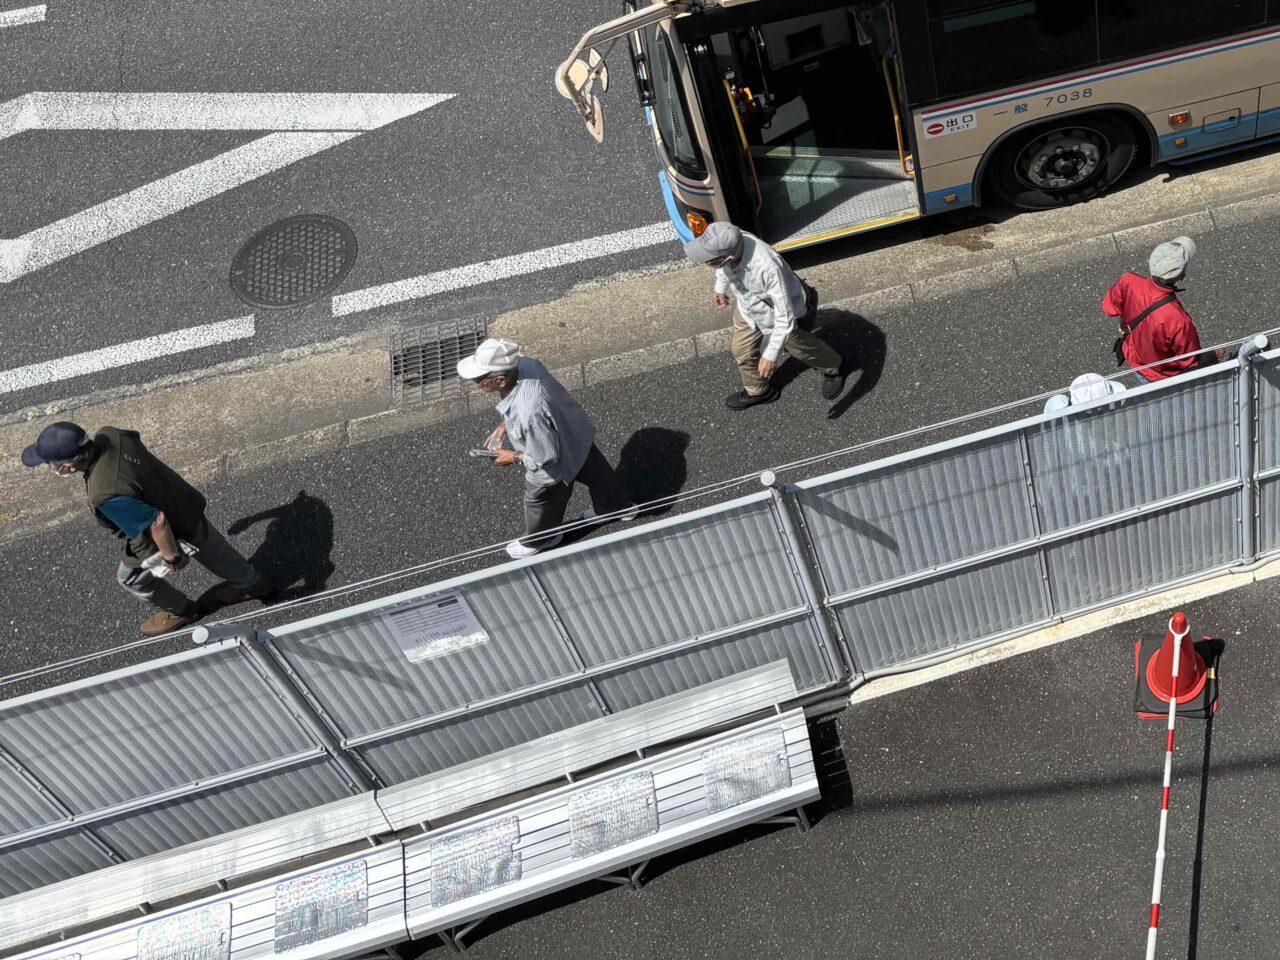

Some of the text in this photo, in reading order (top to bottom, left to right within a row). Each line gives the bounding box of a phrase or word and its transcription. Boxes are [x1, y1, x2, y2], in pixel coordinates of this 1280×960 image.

[1044, 88, 1093, 107] 7038
[946, 114, 973, 127] 出口
[950, 124, 970, 132] EXIT
